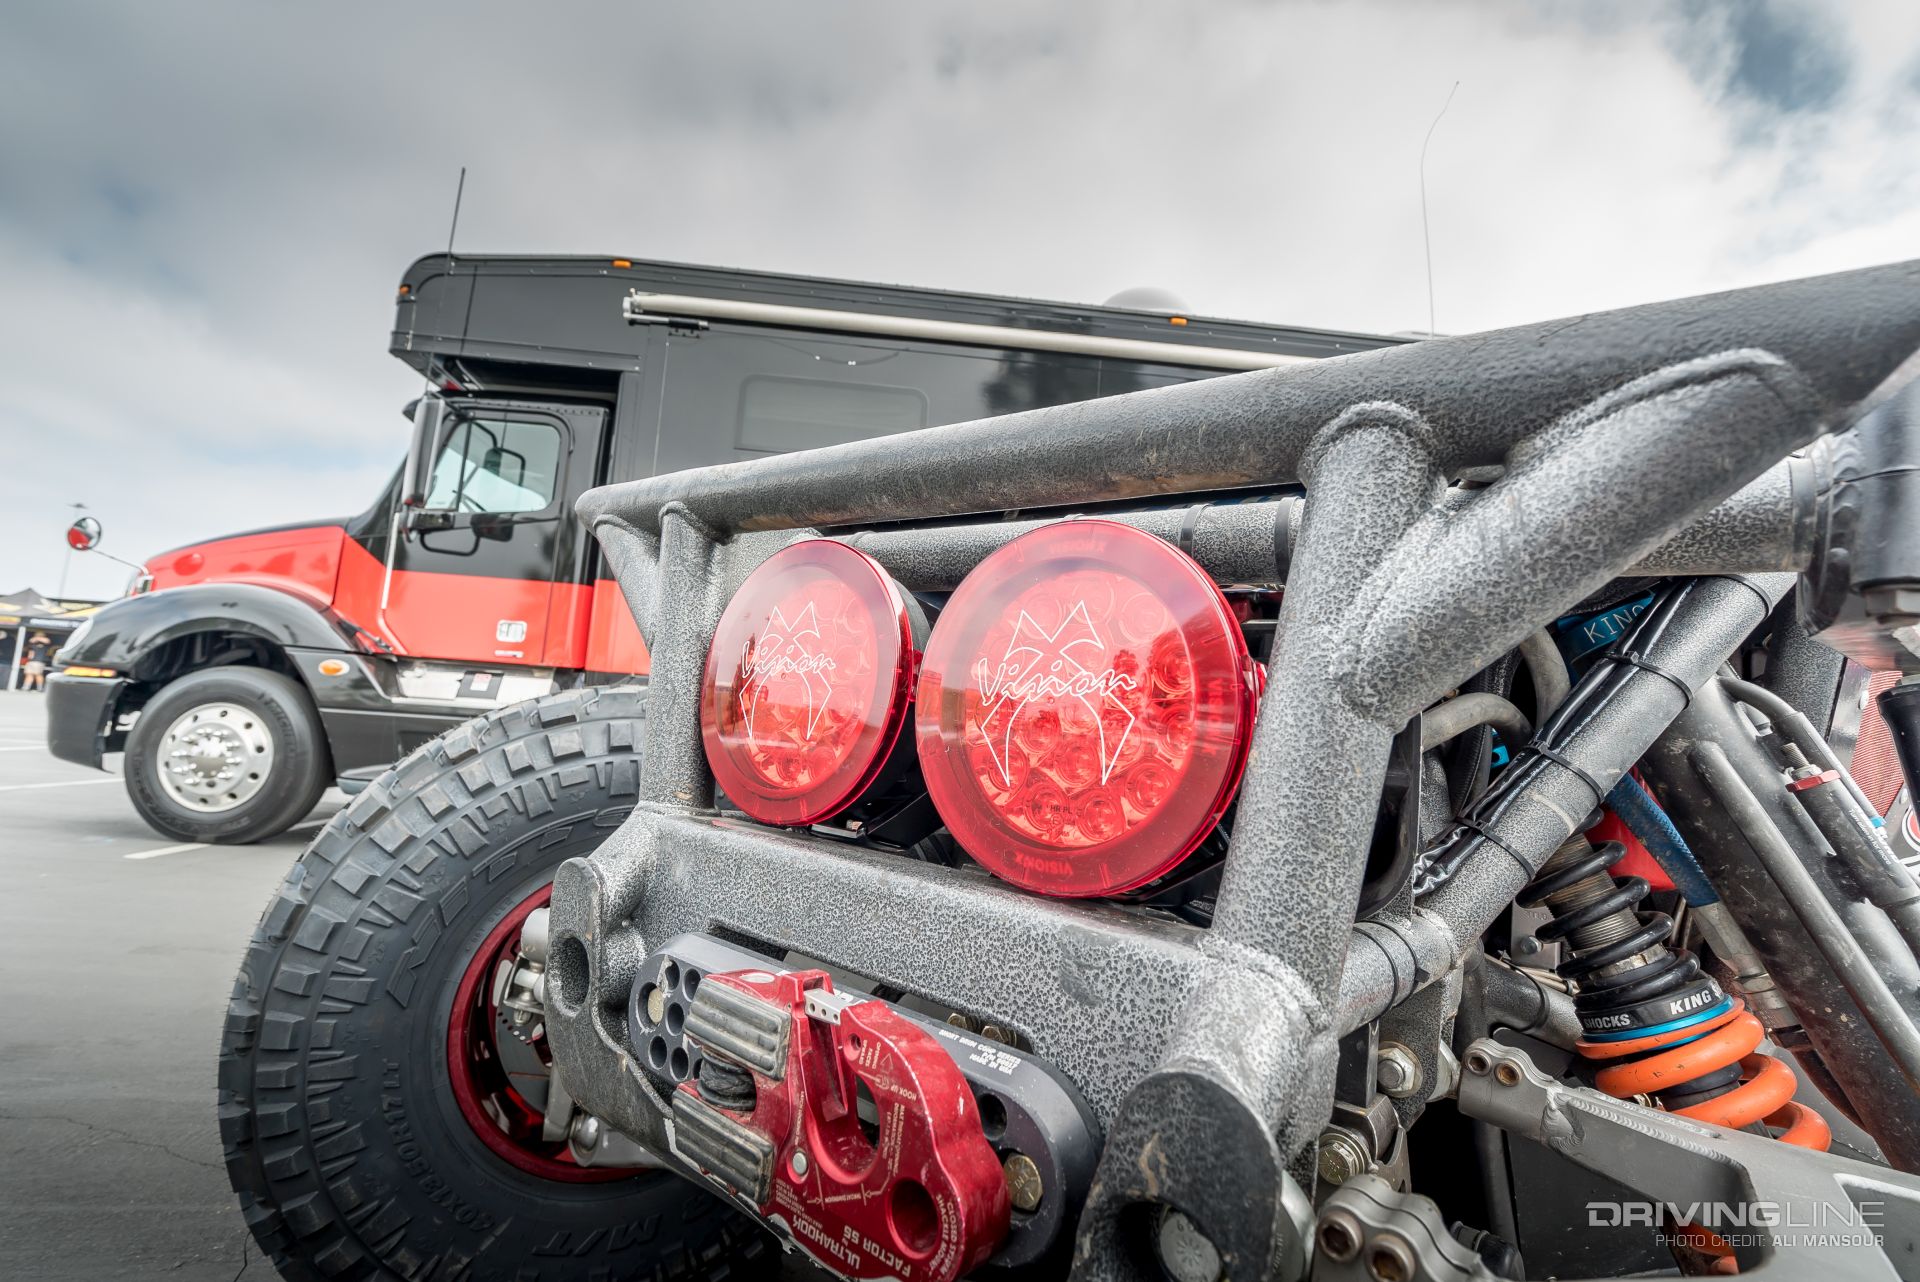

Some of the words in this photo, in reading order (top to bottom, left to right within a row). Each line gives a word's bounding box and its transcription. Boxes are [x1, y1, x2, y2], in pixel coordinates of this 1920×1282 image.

[976, 656, 1138, 708] Vision
[1583, 1014, 1631, 1029] SHOCKS
[1669, 989, 1712, 1015] KING
[899, 1086, 918, 1102] HOOK
[792, 1214, 862, 1270] ULTRAHOOK
[843, 1224, 860, 1245] 55
[862, 1237, 912, 1278] FACTOR
